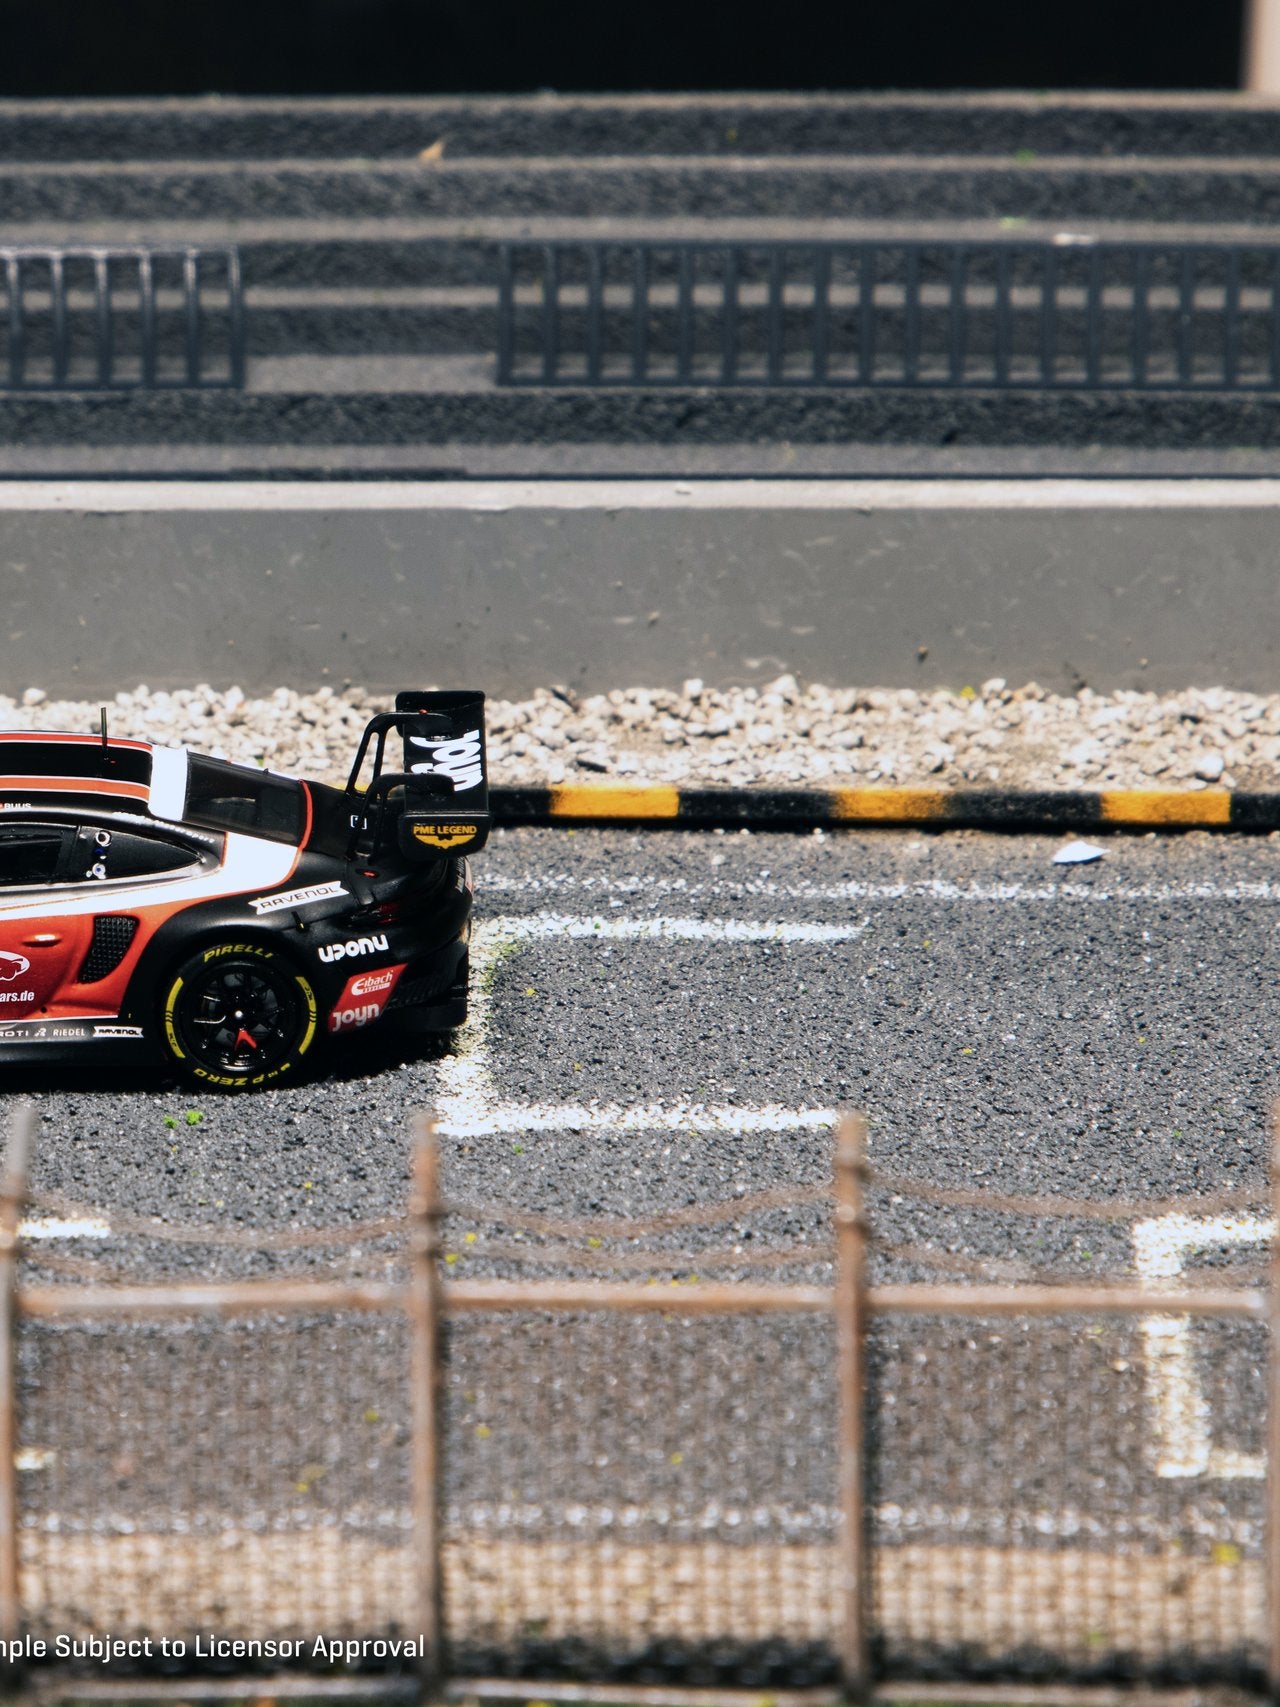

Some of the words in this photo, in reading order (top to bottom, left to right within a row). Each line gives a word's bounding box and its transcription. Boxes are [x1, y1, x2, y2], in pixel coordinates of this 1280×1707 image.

[414, 825, 435, 834] PME
[437, 825, 477, 834] LEGEND
[260, 887, 338, 909] RAVENOL
[203, 944, 274, 963] PIRELLI
[52, 1028, 86, 1037] RIEDEL
